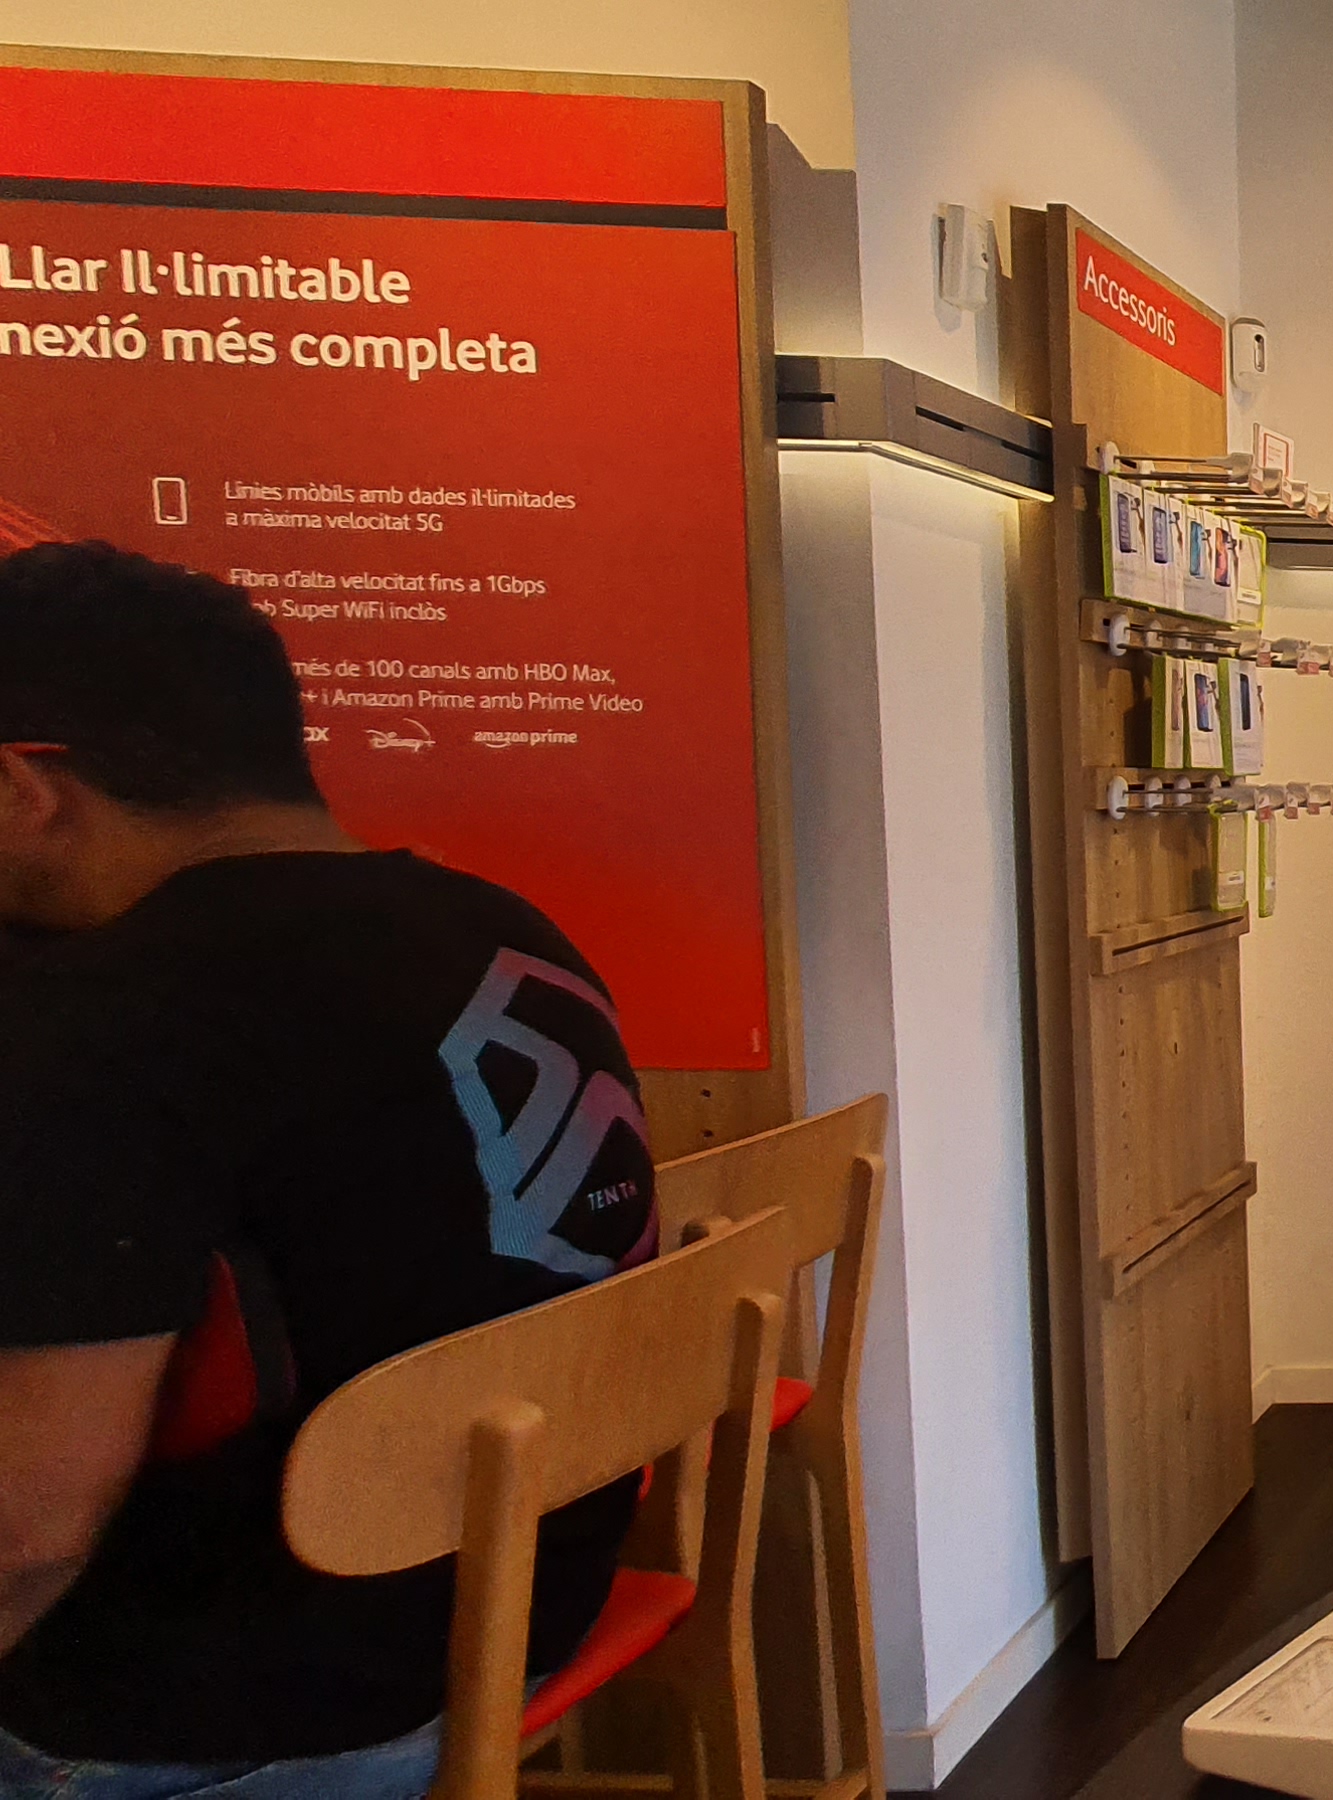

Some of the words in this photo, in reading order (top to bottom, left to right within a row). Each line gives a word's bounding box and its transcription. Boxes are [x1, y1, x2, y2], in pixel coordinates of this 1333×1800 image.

[0, 243, 108, 292] Llar
[1083, 254, 1176, 346] Accessoris
[0, 313, 147, 360] nexió
[162, 317, 276, 364] més
[290, 327, 537, 381] completa
[287, 482, 354, 502] mòbils
[359, 486, 403, 504] amb
[408, 487, 467, 506] dades
[226, 512, 238, 526] a
[243, 509, 322, 528] màxima
[326, 512, 411, 530] velocitat
[416, 513, 443, 532] 5G
[340, 572, 425, 591] velocitat
[430, 573, 465, 592] fins
[469, 579, 481, 592] a
[486, 575, 547, 598] 1Gbps
[282, 600, 340, 621] Super
[343, 601, 384, 619] WiFi
[390, 602, 447, 621] inclòs
[335, 659, 361, 678] de
[367, 659, 404, 679] 100
[408, 662, 472, 680] canals
[475, 664, 519, 681] amb
[524, 663, 568, 682] HBO
[572, 664, 616, 686] Max,
[333, 688, 414, 708] Amazon
[418, 689, 476, 709] Prime
[479, 692, 524, 710] amb
[528, 692, 585, 711] Prime
[588, 694, 644, 712] Video
